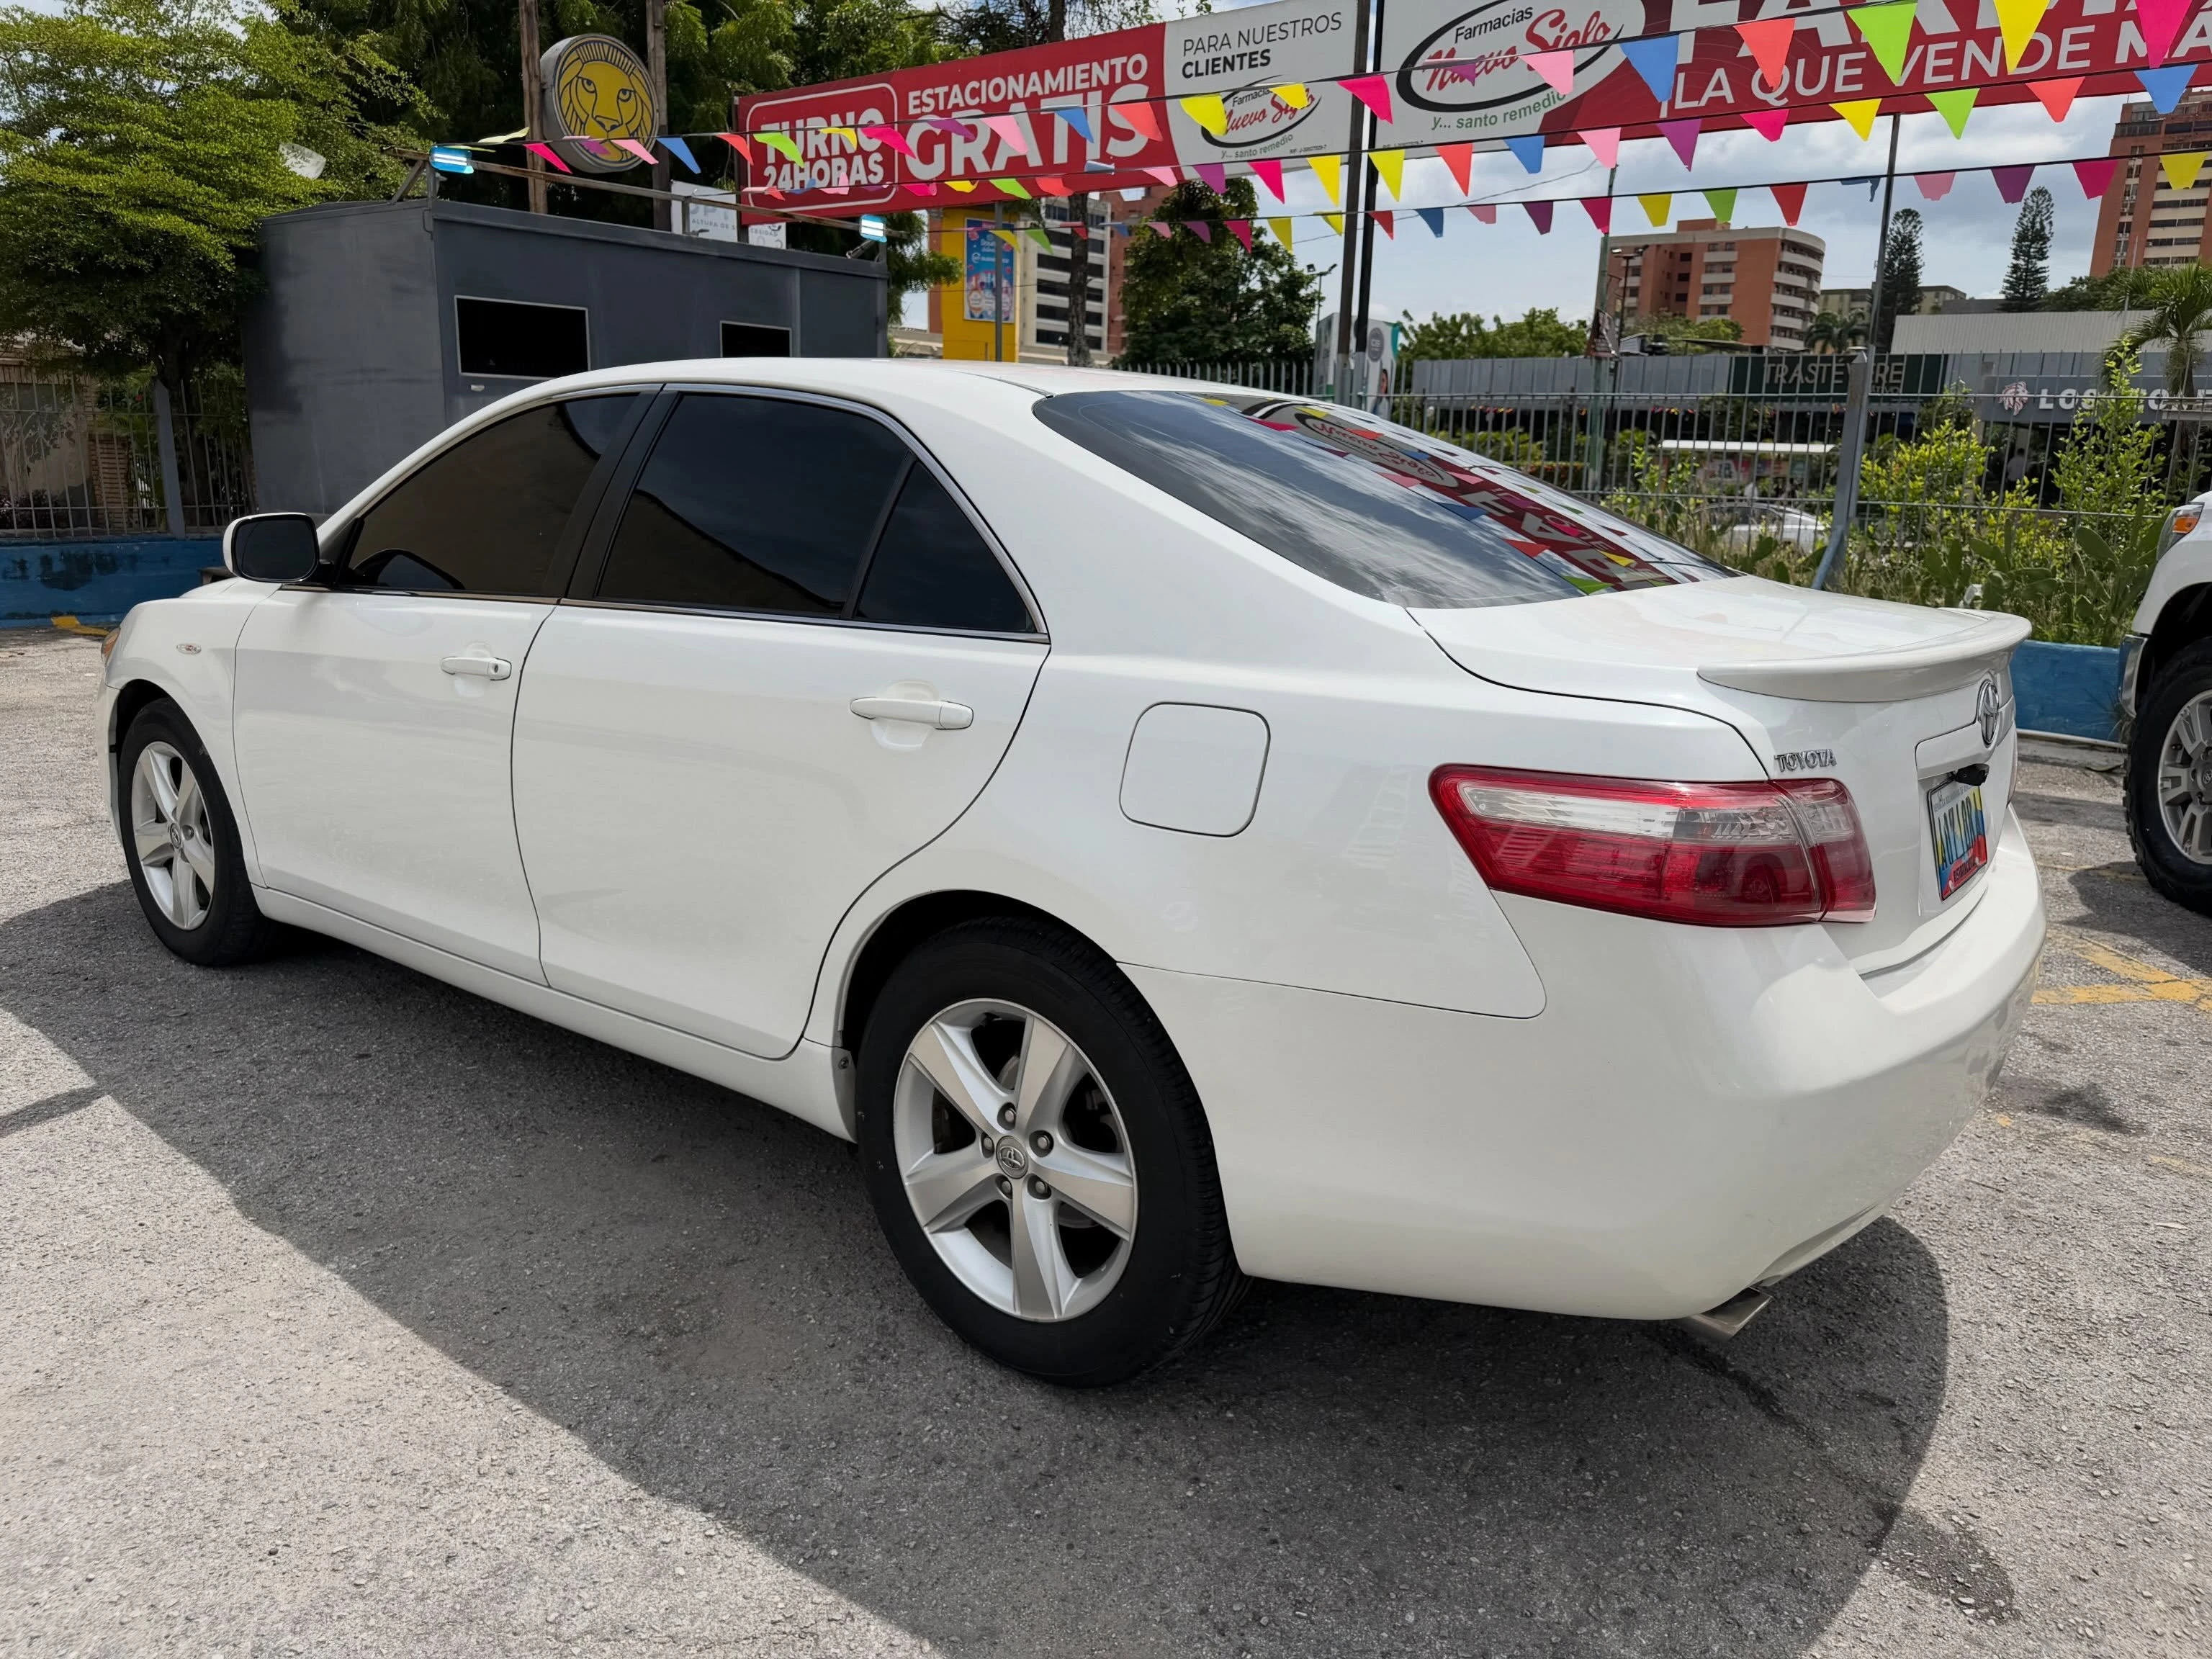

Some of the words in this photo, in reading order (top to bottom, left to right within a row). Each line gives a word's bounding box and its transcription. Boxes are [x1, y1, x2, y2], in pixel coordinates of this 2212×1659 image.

[1183, 33, 1232, 57] PARA
[1238, 12, 1341, 48] NUESTROS
[1455, 6, 1534, 44] Farmacias
[1182, 48, 1272, 79] CLIENTES
[1750, 51, 1867, 107] QUE
[908, 53, 1148, 115] ESTACIONAMIENTO
[1232, 87, 1277, 107] Farmacia
[760, 108, 886, 164] TURNO
[905, 83, 1150, 181] GRATIS
[1456, 114, 1498, 130] santo
[1235, 147, 1258, 158] santo
[1259, 133, 1294, 154] remedio
[1764, 357, 1905, 384] TRASTÉRE
[1773, 749, 1838, 773] TOYOTA
